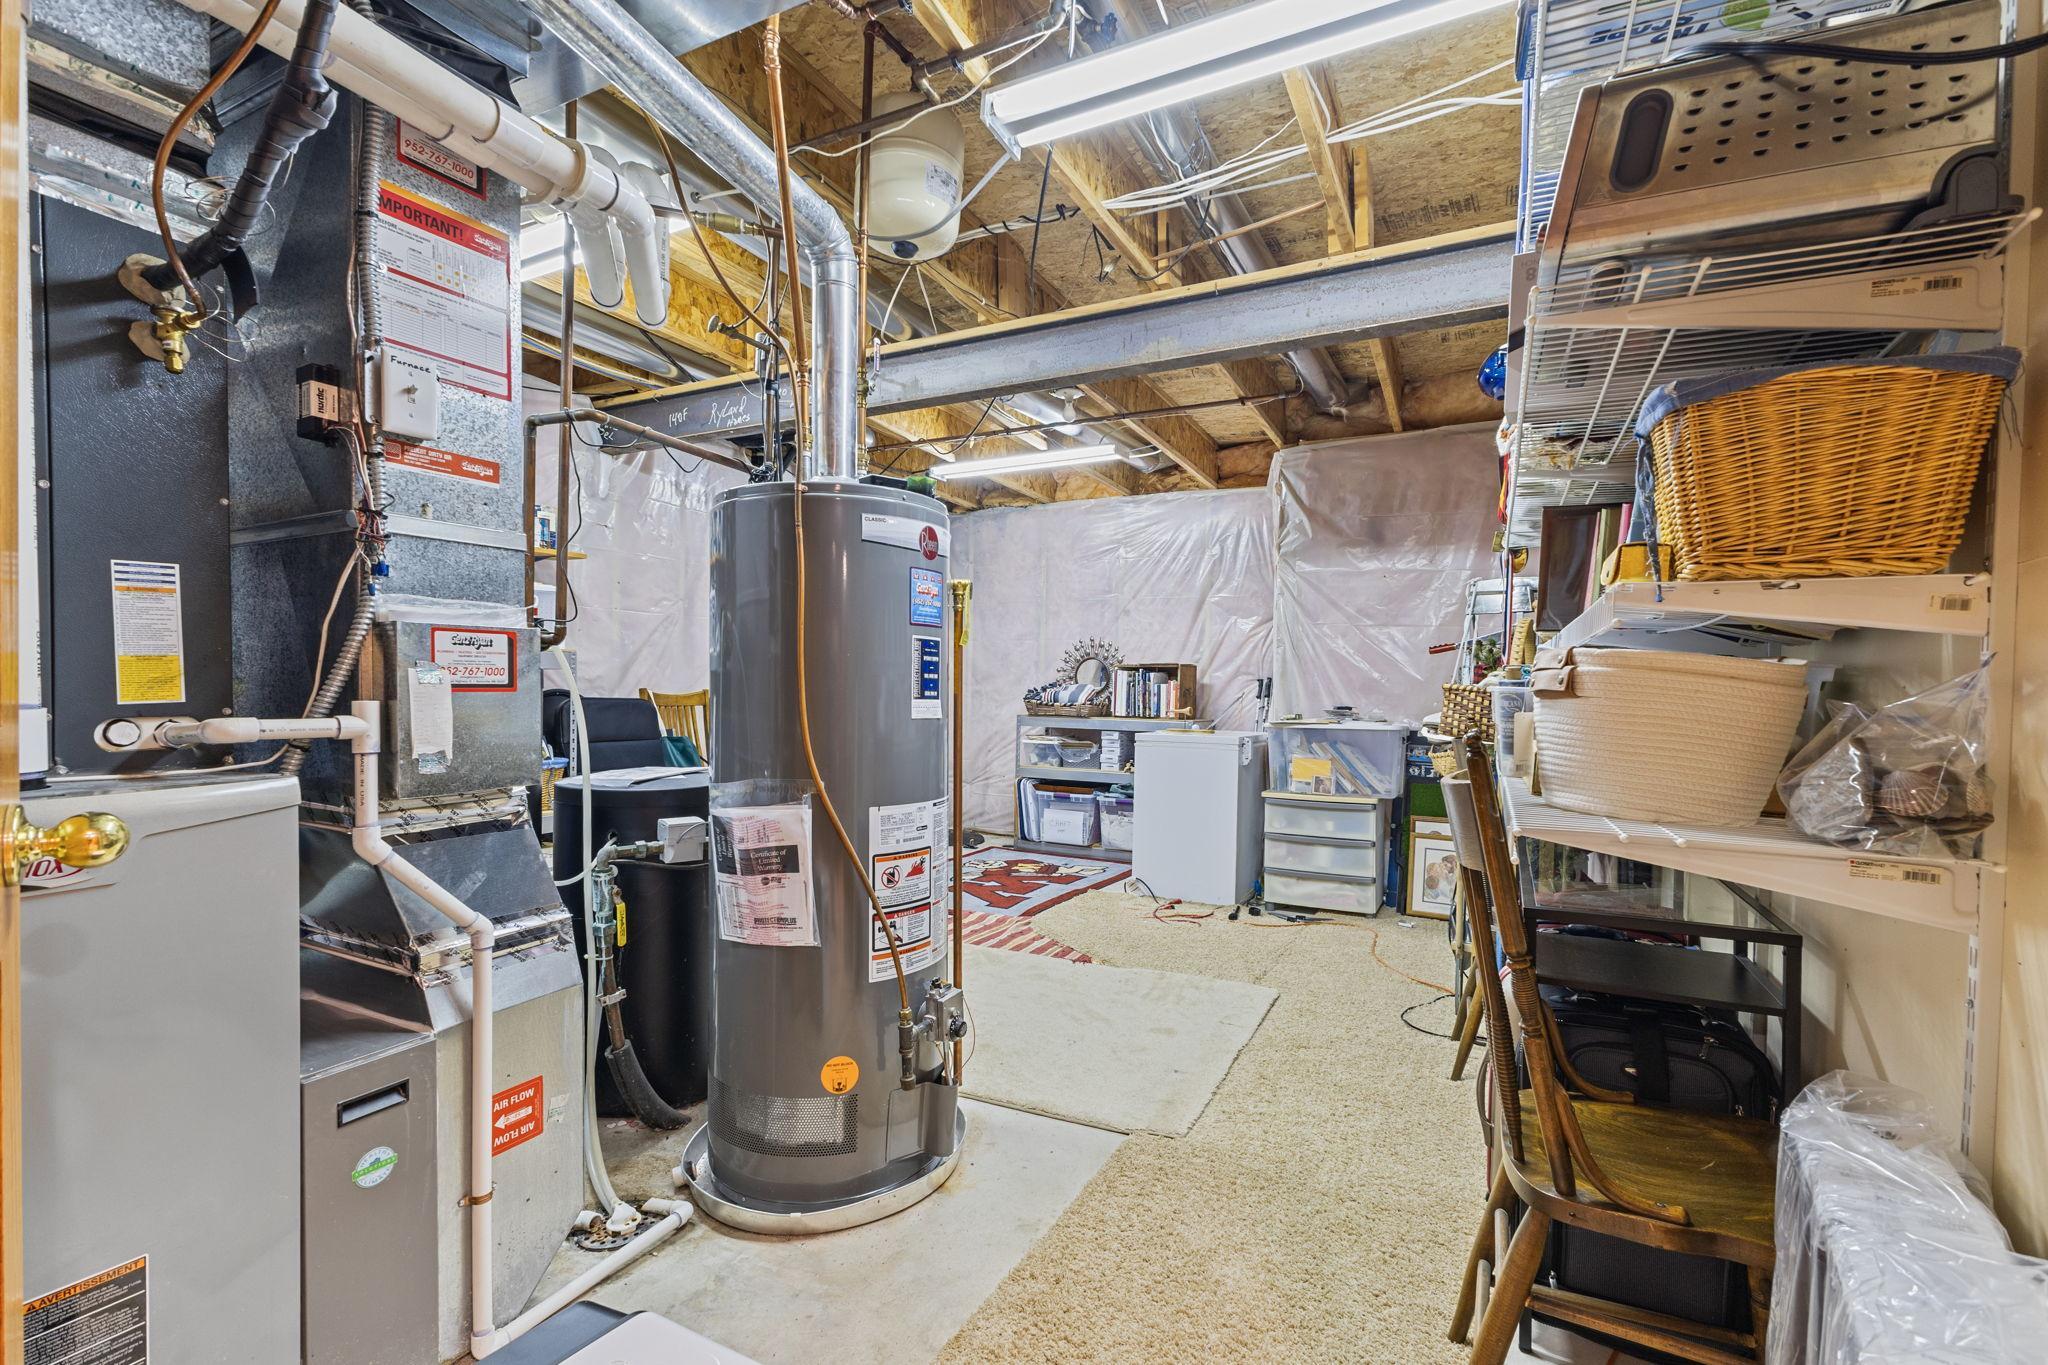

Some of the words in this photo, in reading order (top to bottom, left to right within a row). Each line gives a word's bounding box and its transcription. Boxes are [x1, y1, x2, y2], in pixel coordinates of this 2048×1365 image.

[404, 139, 474, 179] 952-767-1000
[379, 194, 463, 241] MPORTANT!
[390, 355, 431, 374] Furnace
[669, 407, 689, 427] 140F
[493, 1098, 509, 1112] AIR
[511, 1088, 535, 1105] FLOW
[494, 1128, 519, 1147] FLOW
[520, 1121, 535, 1135] AIR
[38, 1261, 140, 1309] AVERTISSEMENT
